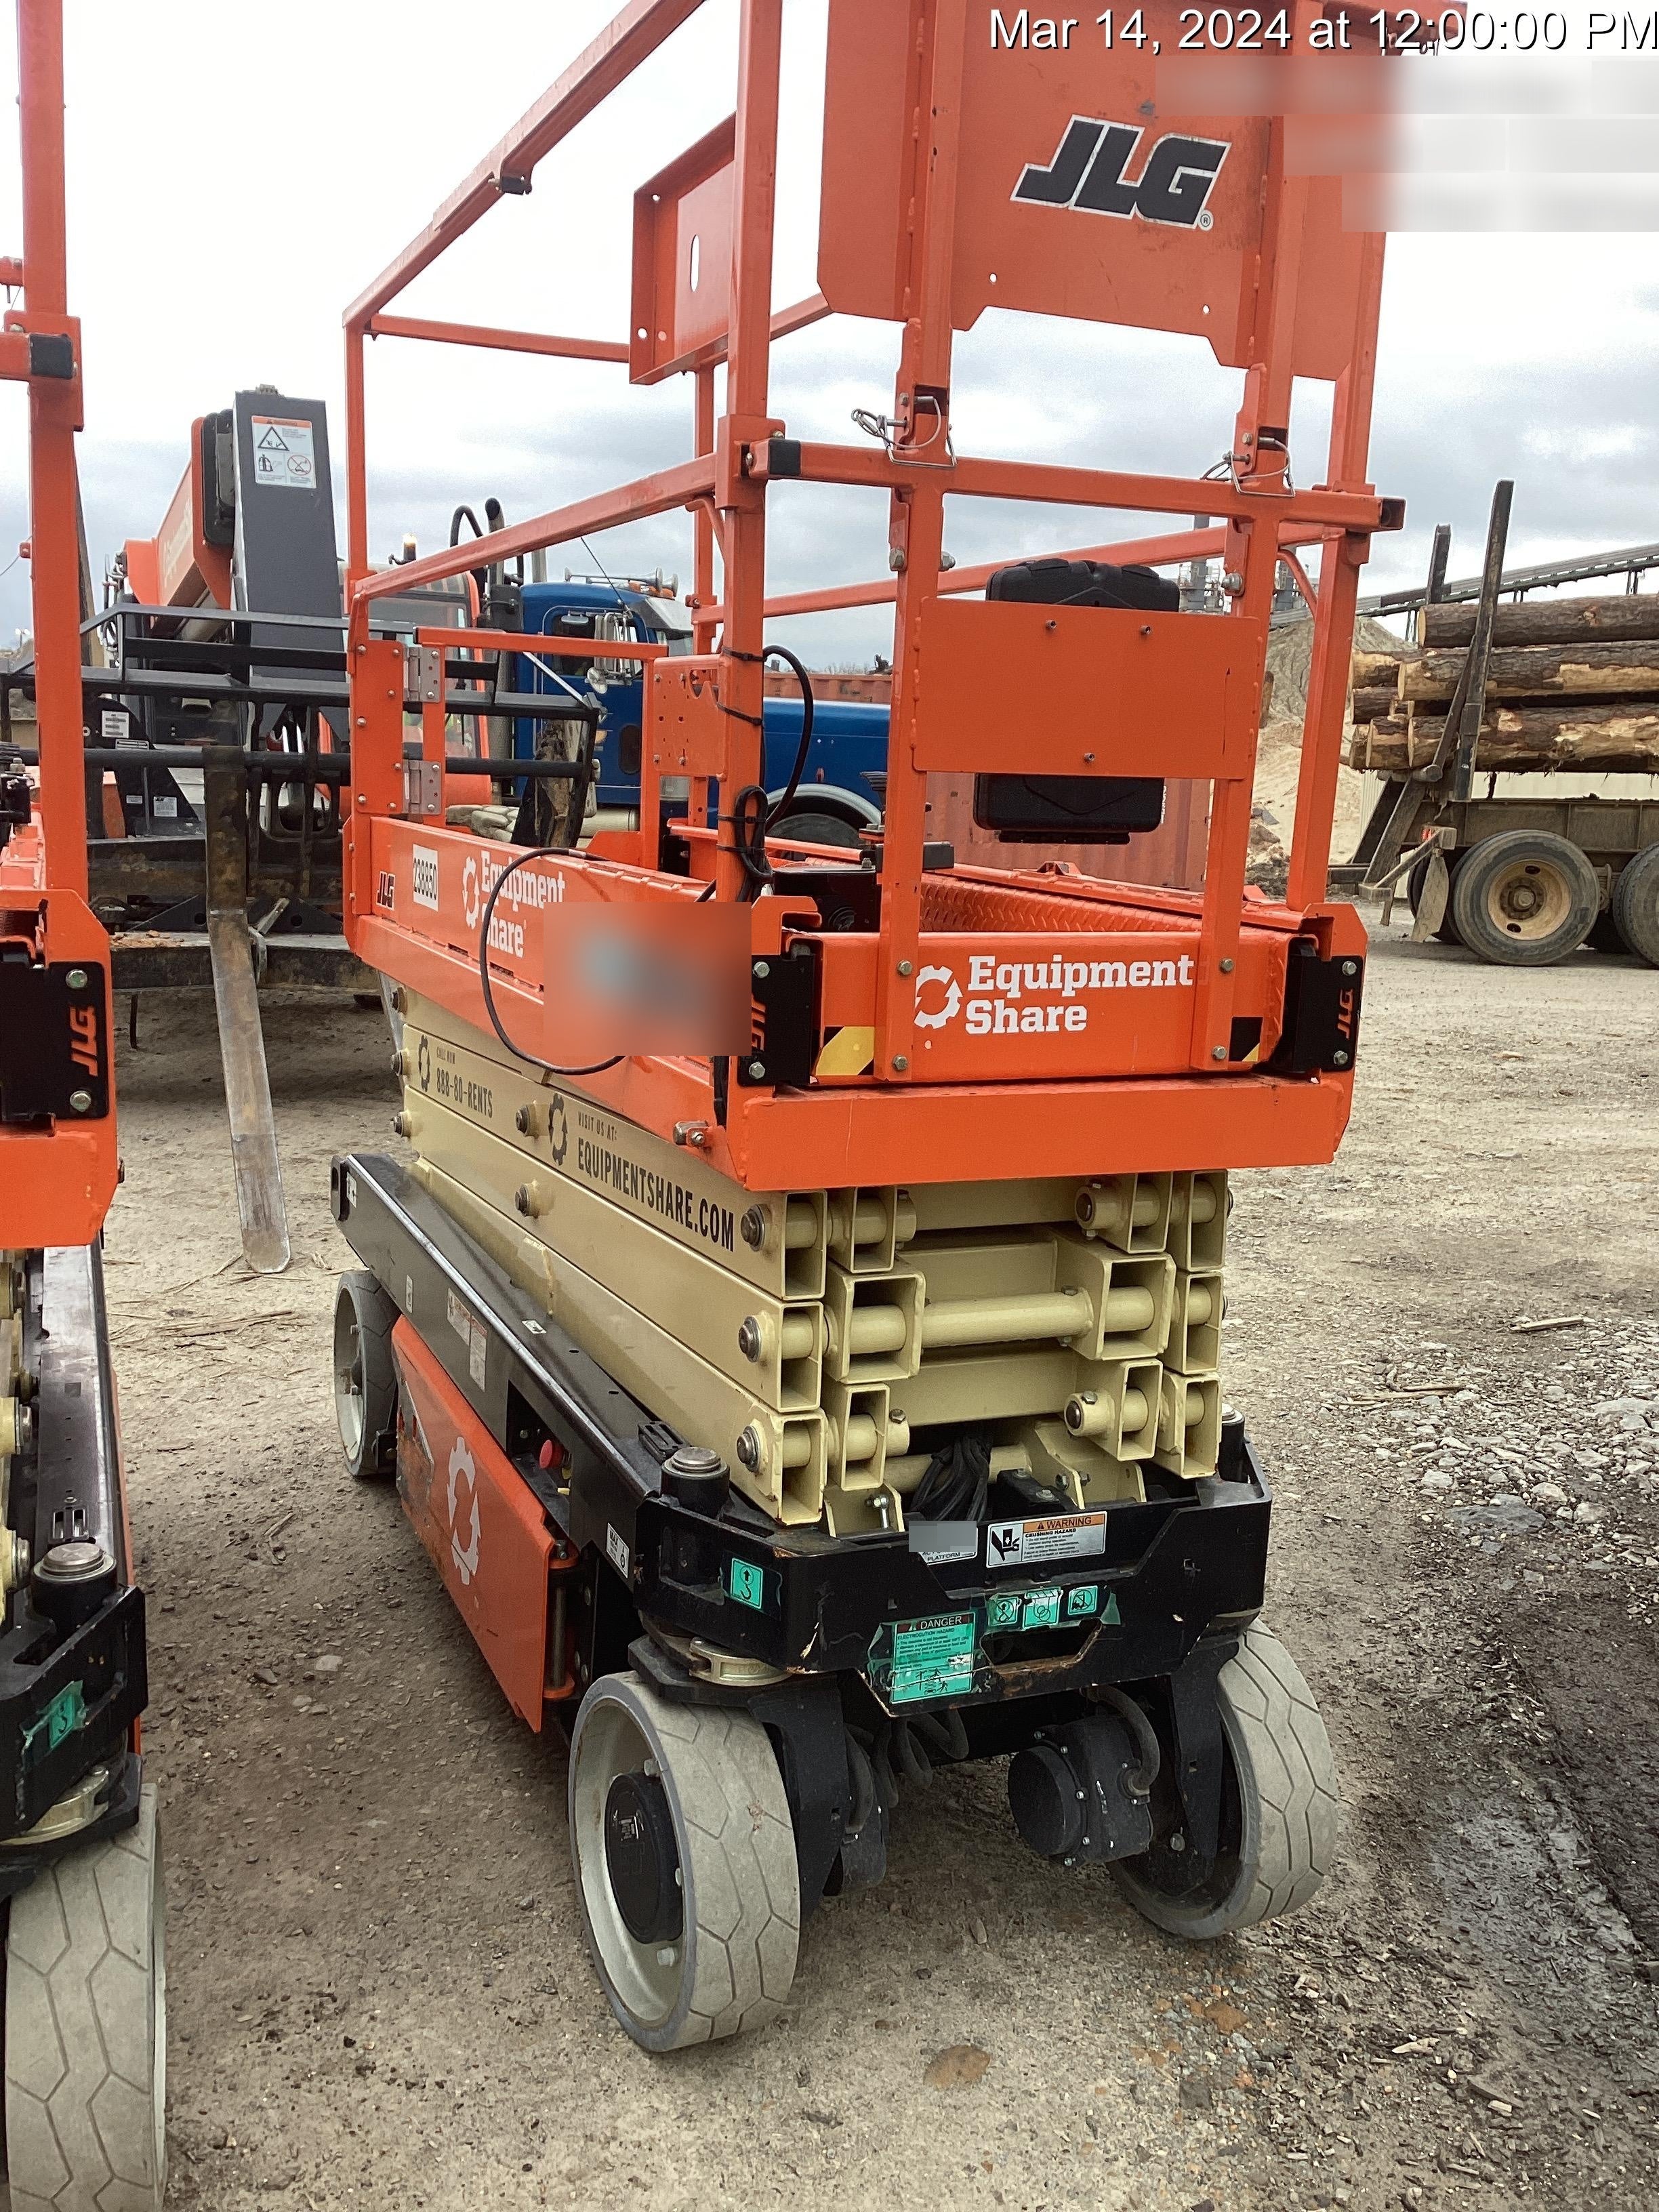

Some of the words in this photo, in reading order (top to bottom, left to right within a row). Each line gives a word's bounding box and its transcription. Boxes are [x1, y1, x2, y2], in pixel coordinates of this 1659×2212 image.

[1011, 115, 1231, 228] JLG
[375, 870, 395, 911] JLG
[413, 857, 438, 901] 238850
[480, 850, 566, 912] Equipment
[967, 954, 1195, 998] Equipment
[965, 999, 1088, 1034] Share
[1337, 988, 1353, 1040] JLG
[70, 1003, 98, 1077] JLG
[436, 1067, 493, 1119] 888-80-RENTS
[577, 1111, 594, 1132] VISIT
[596, 1119, 605, 1136] US
[607, 1124, 617, 1143] AT:
[578, 1137, 734, 1252] EQUIPMENTSHARE.COM
[1047, 1517, 1092, 1530] WARNING
[927, 1552, 960, 1561] PLATFORM
[920, 1616, 962, 1629] DANGER
